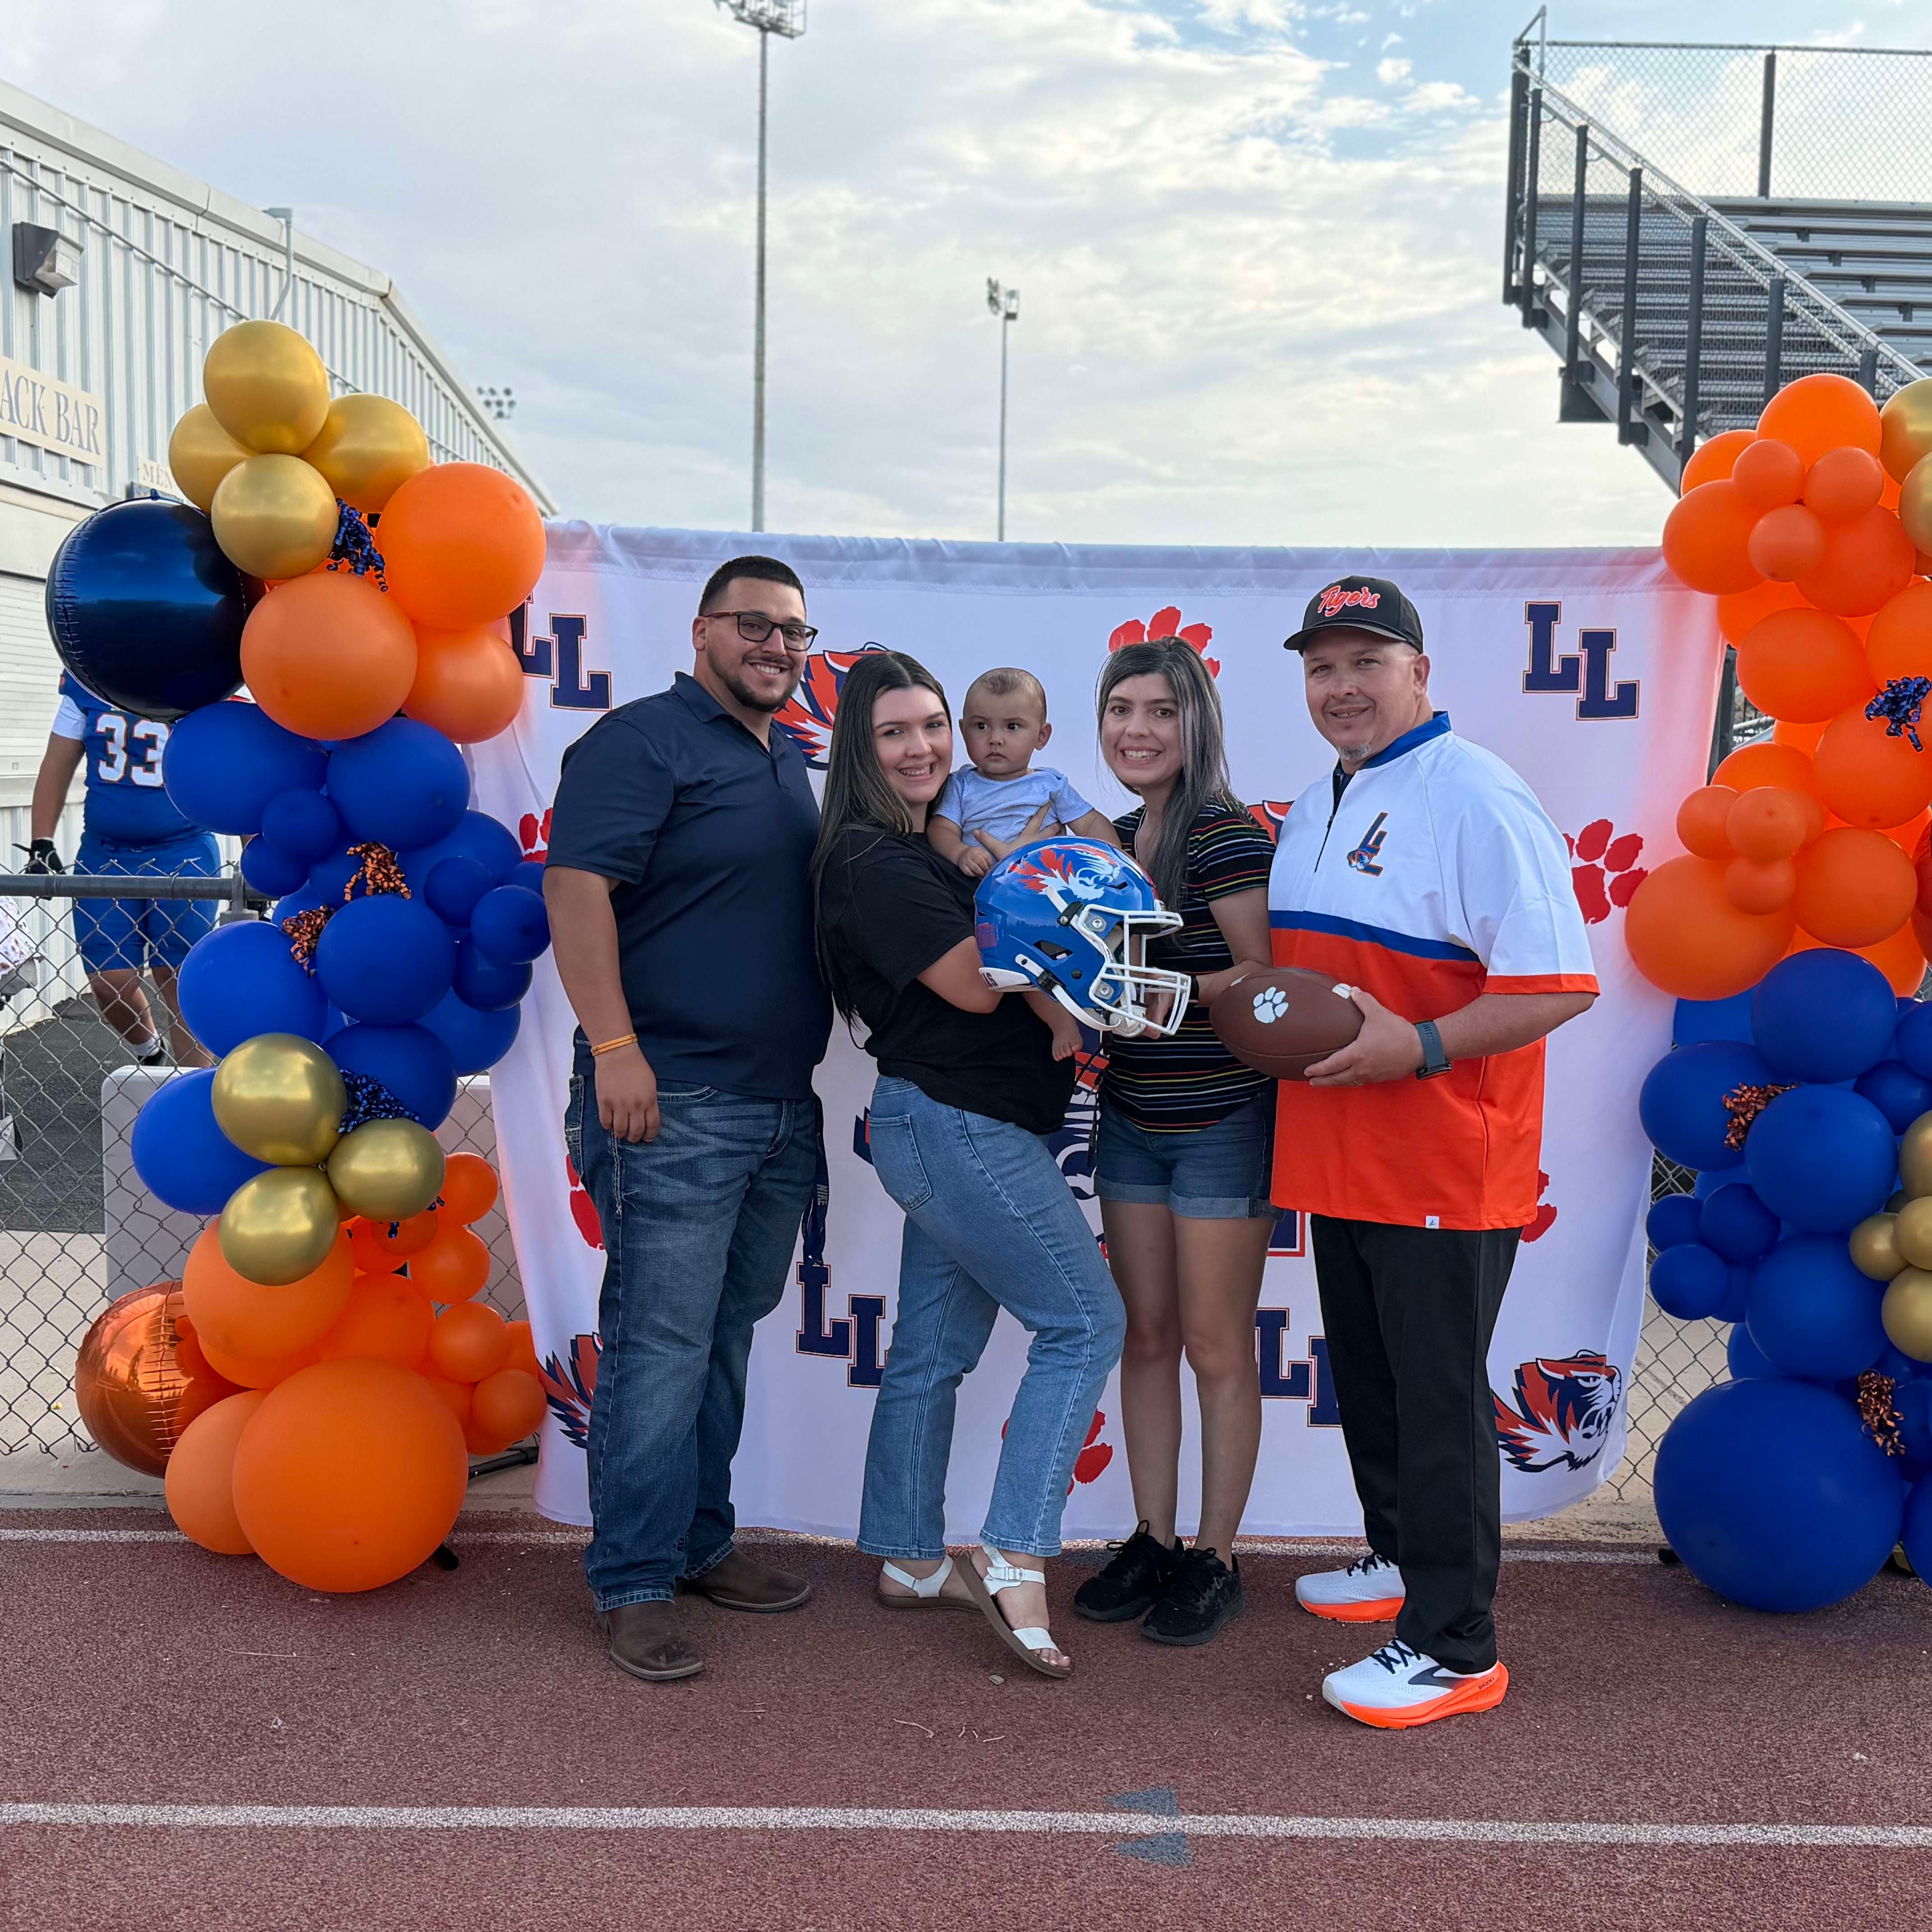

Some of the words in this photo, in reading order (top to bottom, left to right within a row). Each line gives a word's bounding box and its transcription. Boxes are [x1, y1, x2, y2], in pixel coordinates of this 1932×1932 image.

[54, 391, 101, 455] BAR
[143, 462, 173, 490] MEN
[1317, 585, 1381, 617] Tigers
[1522, 601, 1640, 721] LL
[95, 712, 172, 787] 33
[817, 1183, 828, 1206] NIKE
